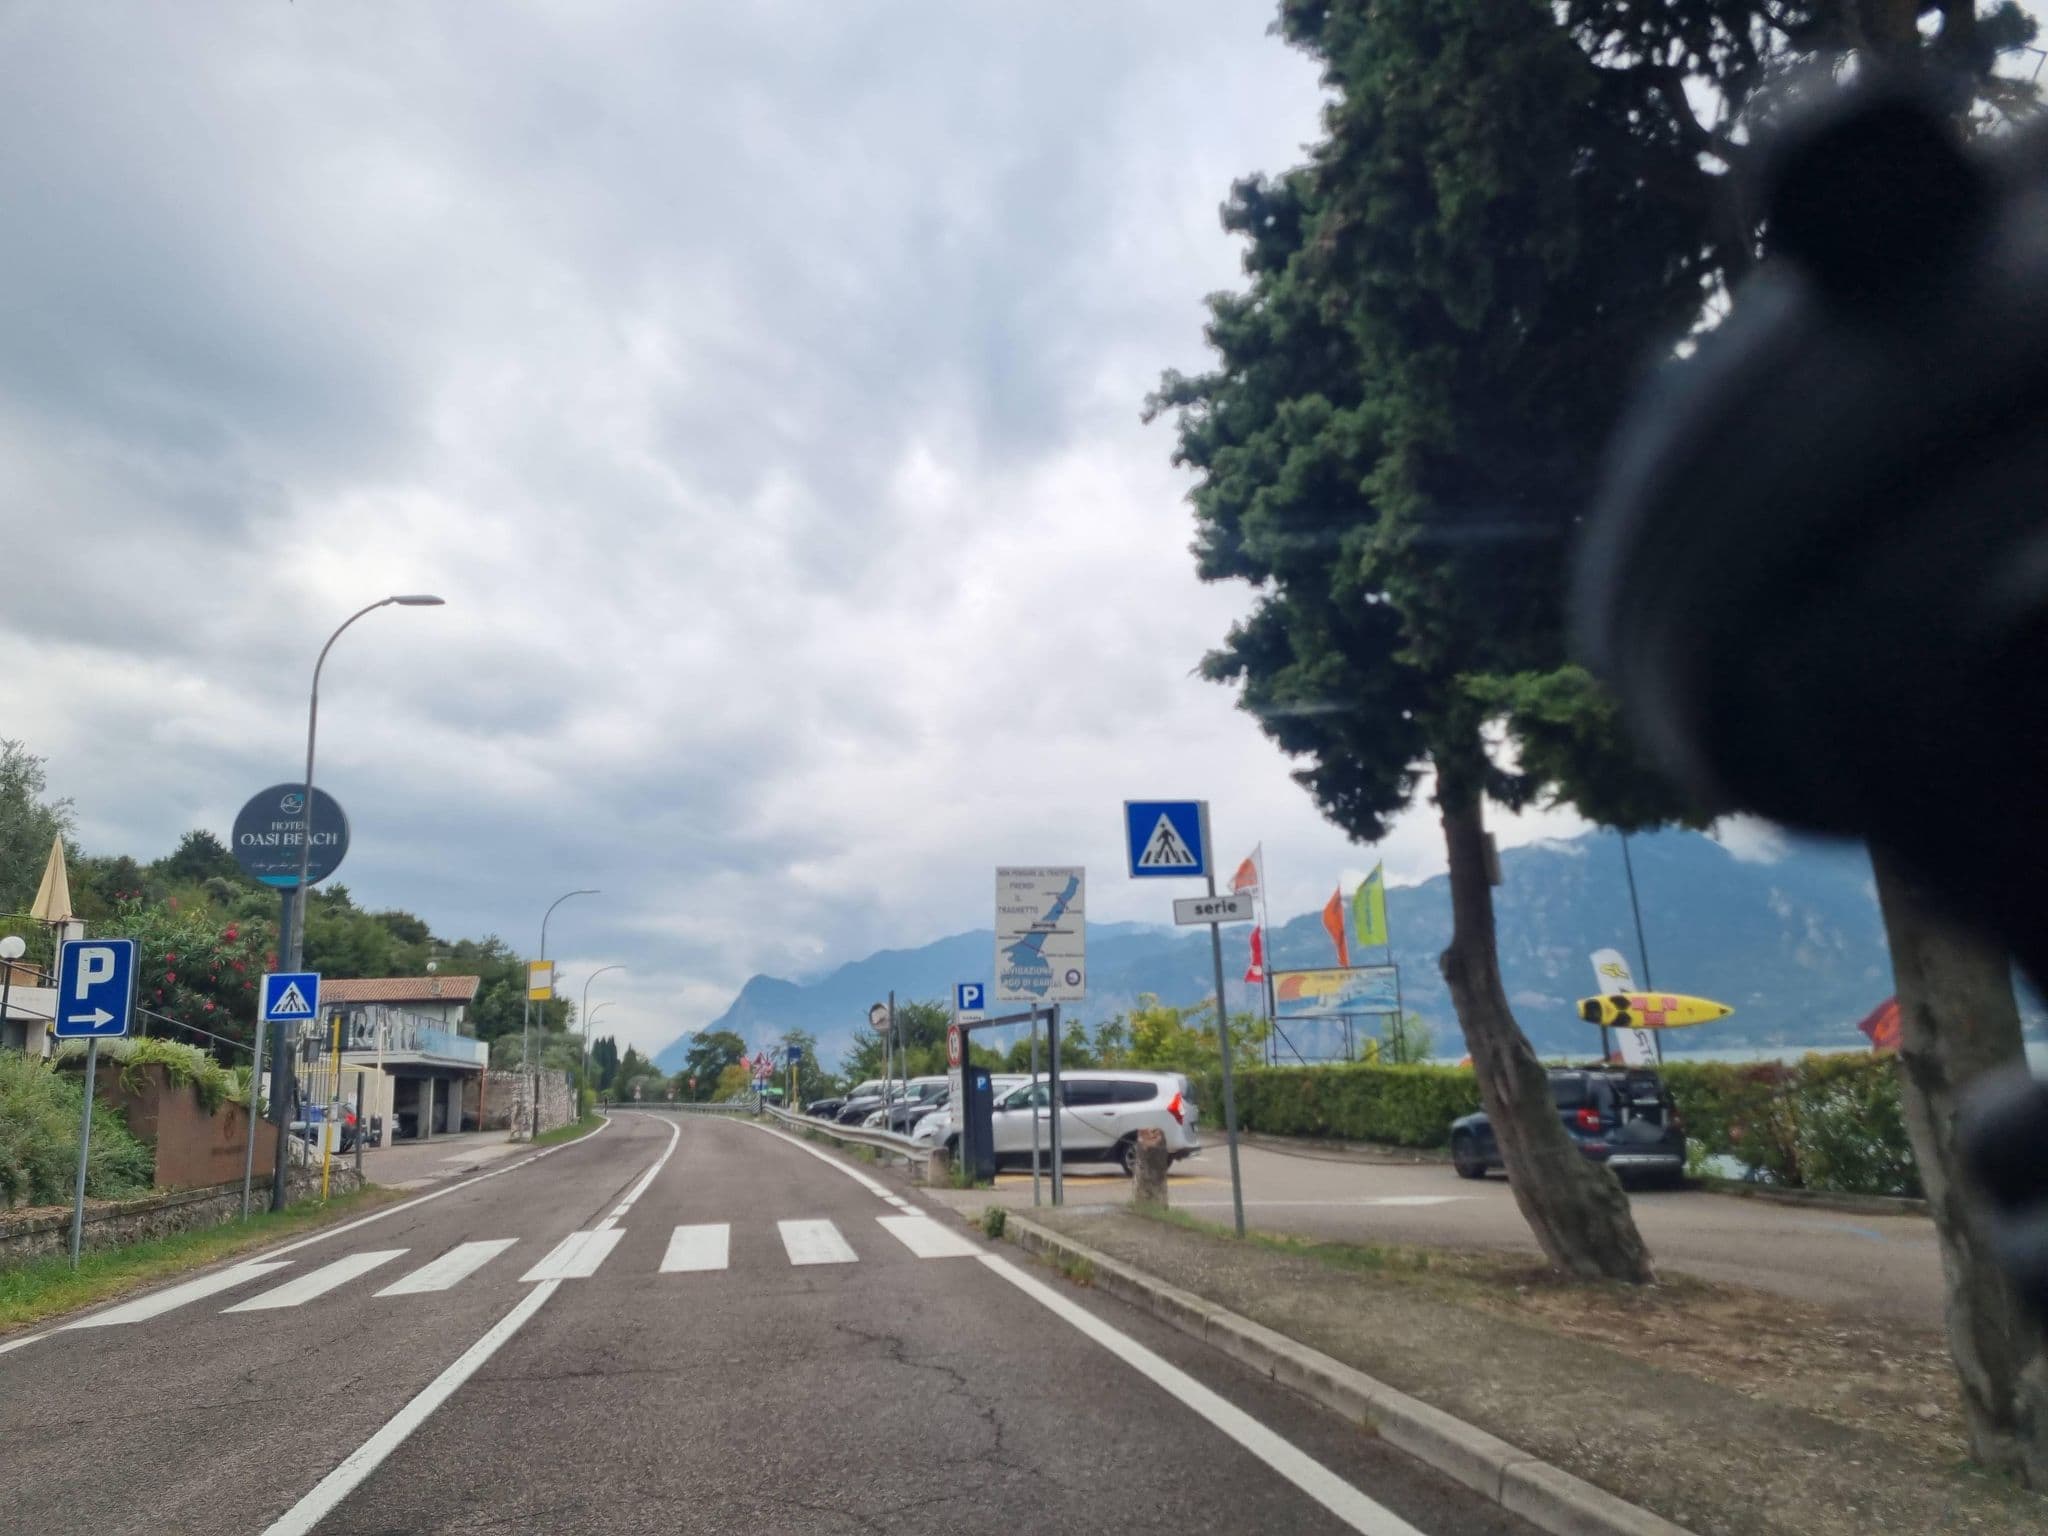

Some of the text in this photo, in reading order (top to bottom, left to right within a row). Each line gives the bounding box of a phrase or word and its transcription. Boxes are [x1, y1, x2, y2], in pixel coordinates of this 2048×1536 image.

[241, 832, 338, 846] OASI BEACH
[1195, 901, 1238, 915] serie
[76, 947, 116, 1000] P
[962, 986, 979, 1008] P
